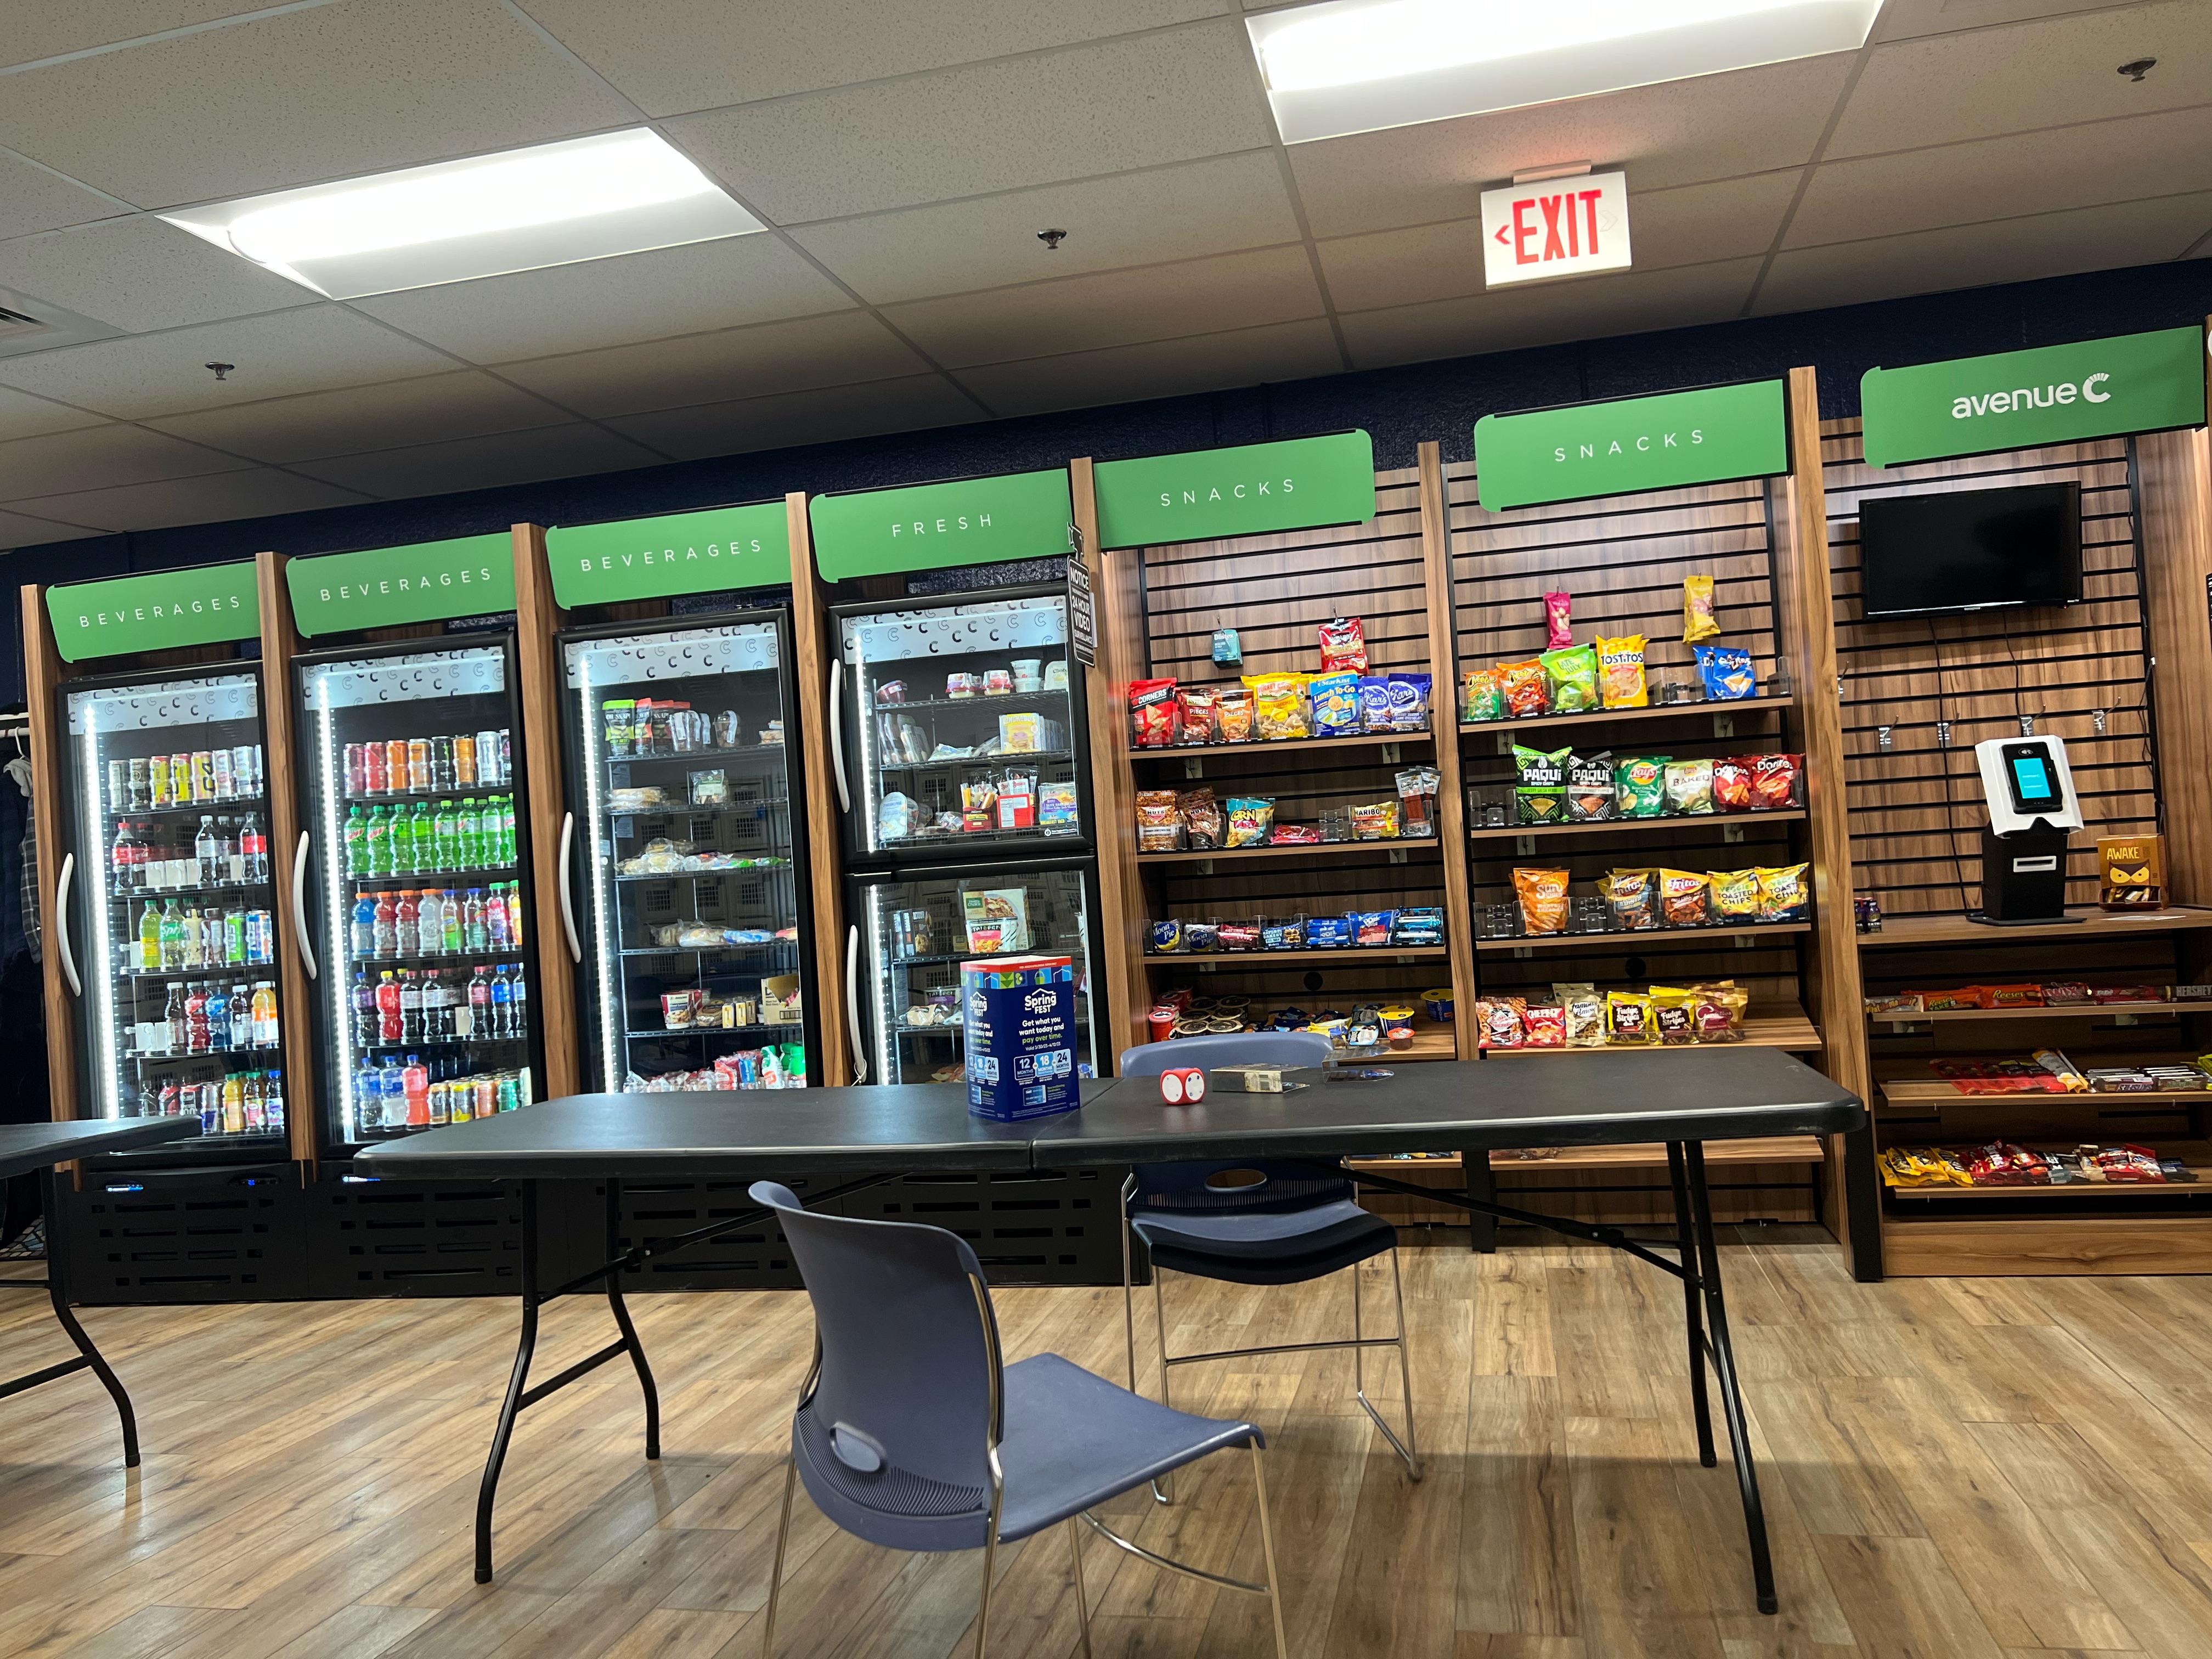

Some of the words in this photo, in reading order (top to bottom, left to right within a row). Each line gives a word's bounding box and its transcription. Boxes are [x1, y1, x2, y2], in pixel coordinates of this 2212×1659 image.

[1513, 189, 1602, 265] EXIT
[1554, 430, 1703, 462] SNACKS
[1161, 479, 1294, 506] SNACKS
[892, 514, 991, 537] FRESH
[580, 539, 760, 572] BEVERAGES
[1069, 567, 1089, 590] NOTICE
[320, 568, 490, 601] BEVERAGES
[1072, 595, 1079, 608] 24
[1078, 598, 1090, 616] HOUR
[79, 596, 239, 628] BEVERAGES
[1073, 610, 1091, 633] VIDEO
[1558, 658, 1573, 670] LATE
[1601, 652, 1643, 665] TOSTITOS
[1566, 664, 1581, 674] JULY
[1673, 775, 1710, 786] BAKED
[1230, 809, 1257, 822] CORN
[2106, 847, 2140, 860] AWAKE
[1769, 882, 1797, 894] TOAST
[1718, 890, 1753, 899] TOASTED
[1722, 896, 1752, 905] CHIPS
[1164, 929, 1175, 940] Pie
[1187, 933, 1207, 943] Moon
[969, 996, 987, 1012] Spring
[1024, 994, 1057, 1008] Spring
[1035, 1005, 1052, 1014] FEST
[1616, 1007, 1639, 1015] Fudge
[1661, 1010, 1682, 1019] Fudge
[1051, 1017, 1061, 1025] you
[1616, 1014, 1640, 1023] Stripes
[1662, 1017, 1685, 1026] Stripes
[1036, 1025, 1053, 1035] today
[1022, 1036, 1034, 1045] pay
[1040, 1055, 1049, 1066] 18
[1057, 1052, 1068, 1063] 24
[988, 1059, 996, 1070] 24
[1019, 1058, 1031, 1069] 12
